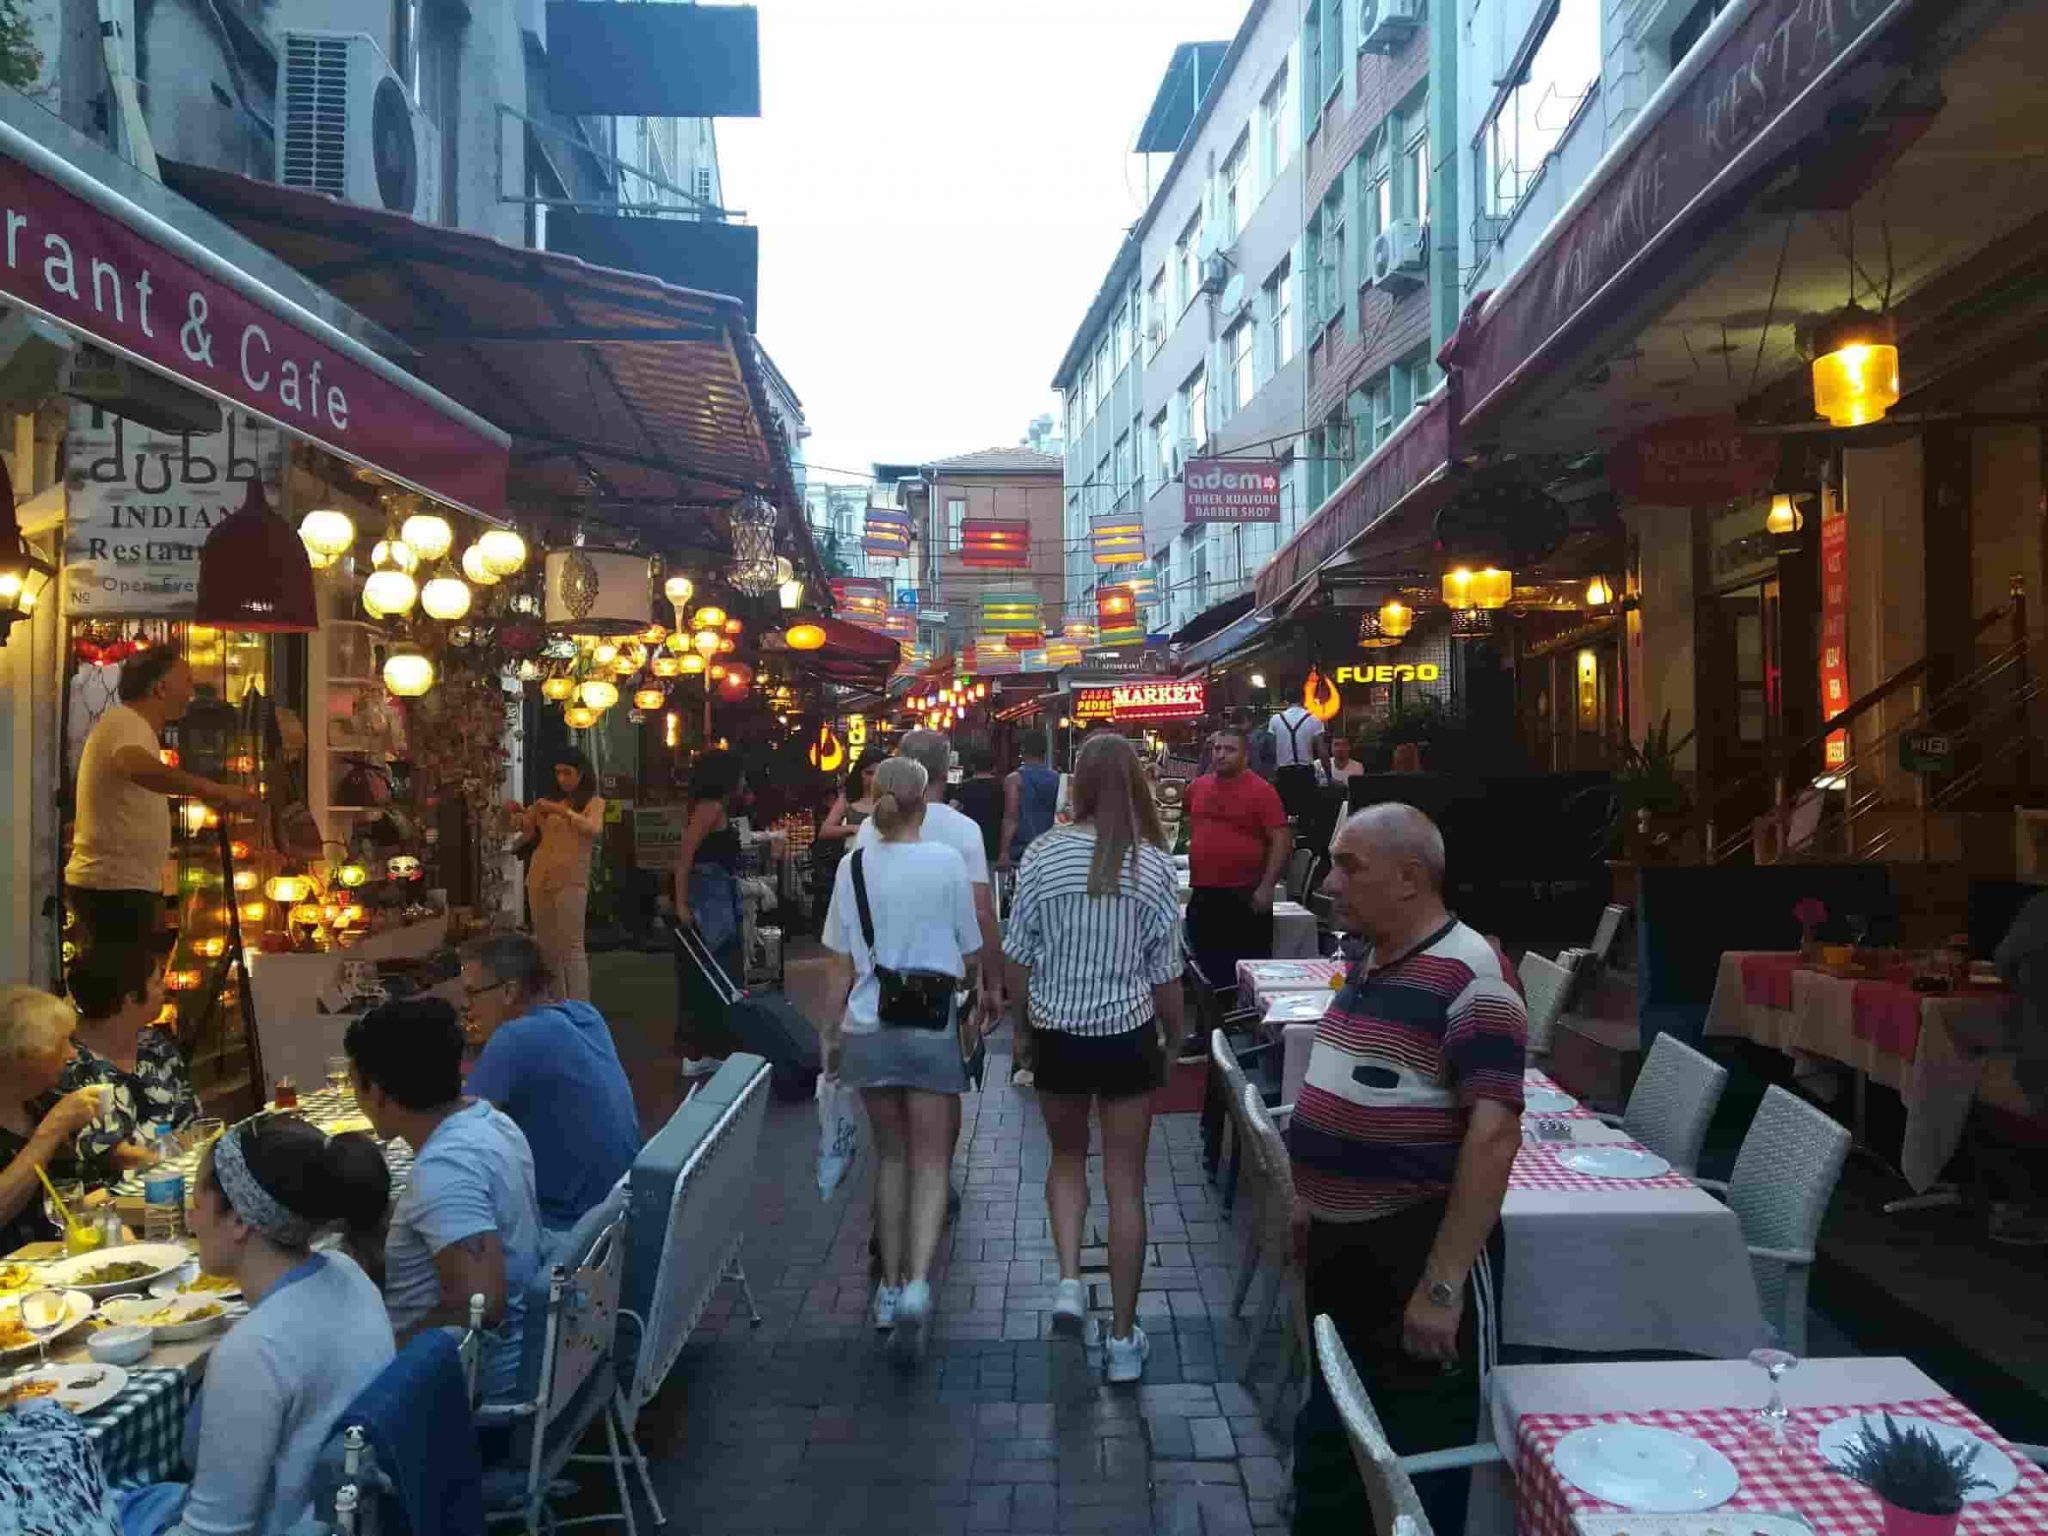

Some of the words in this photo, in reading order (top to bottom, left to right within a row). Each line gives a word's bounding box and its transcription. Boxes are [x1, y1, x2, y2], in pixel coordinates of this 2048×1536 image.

[1706, 0, 1863, 152] RESTA
[6, 209, 154, 338] rant
[180, 292, 214, 368] &
[241, 325, 348, 430] Cafe
[1188, 466, 1262, 489] adem
[1241, 507, 1271, 517] SHOP
[88, 537, 194, 561] Restau
[103, 577, 151, 594] Open
[162, 576, 198, 593] Eve
[1336, 663, 1440, 684] FUEGO
[1080, 689, 1110, 700] CASA
[1114, 685, 1200, 705] MARKET
